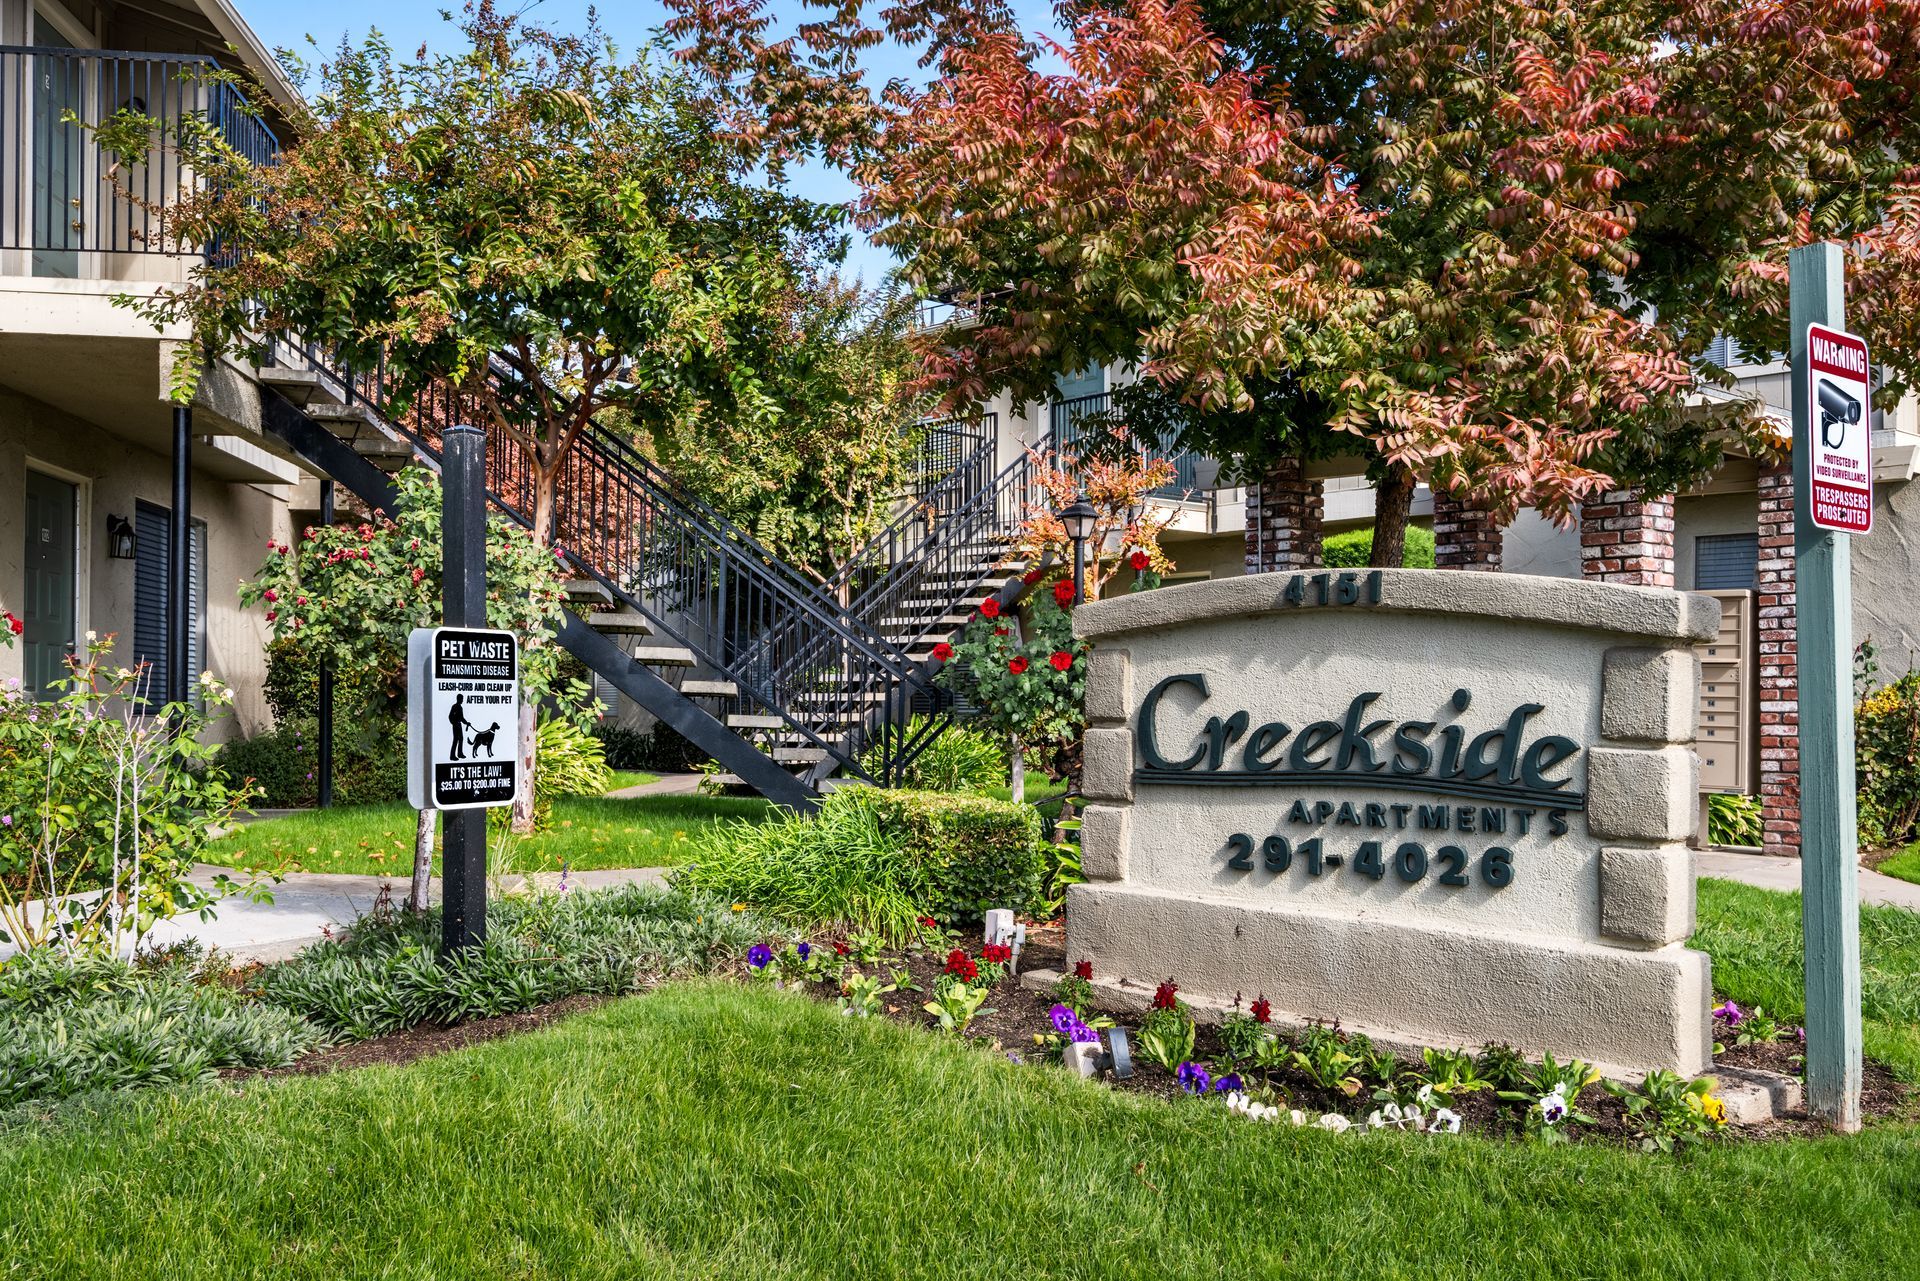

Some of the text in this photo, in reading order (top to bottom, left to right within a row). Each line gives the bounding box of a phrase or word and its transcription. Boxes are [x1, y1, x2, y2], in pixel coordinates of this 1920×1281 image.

[1812, 336, 1865, 374] WARNING
[1823, 453, 1859, 469] PROTECTED BY
[1816, 465, 1867, 483] VIDEO SURVEILLANCE
[1815, 486, 1868, 510] TRESPASSERS
[1817, 503, 1867, 525] PROSECUTED
[1285, 570, 1383, 606] 4151
[441, 640, 510, 659] PET WASTE
[442, 664, 510, 676] TRANSMITS DISEASE
[439, 682, 513, 692] LEASH-CURB AND CLEAN UP
[466, 695, 513, 705] AFTER YOUR PET
[1136, 673, 1582, 790] Creekside
[450, 766, 502, 780] IT'S THE LAW!
[441, 778, 511, 792] $25.00 TO $200.00 FINE
[1287, 799, 1570, 837] APARTMENTS
[1227, 833, 1516, 888] 291-4026
